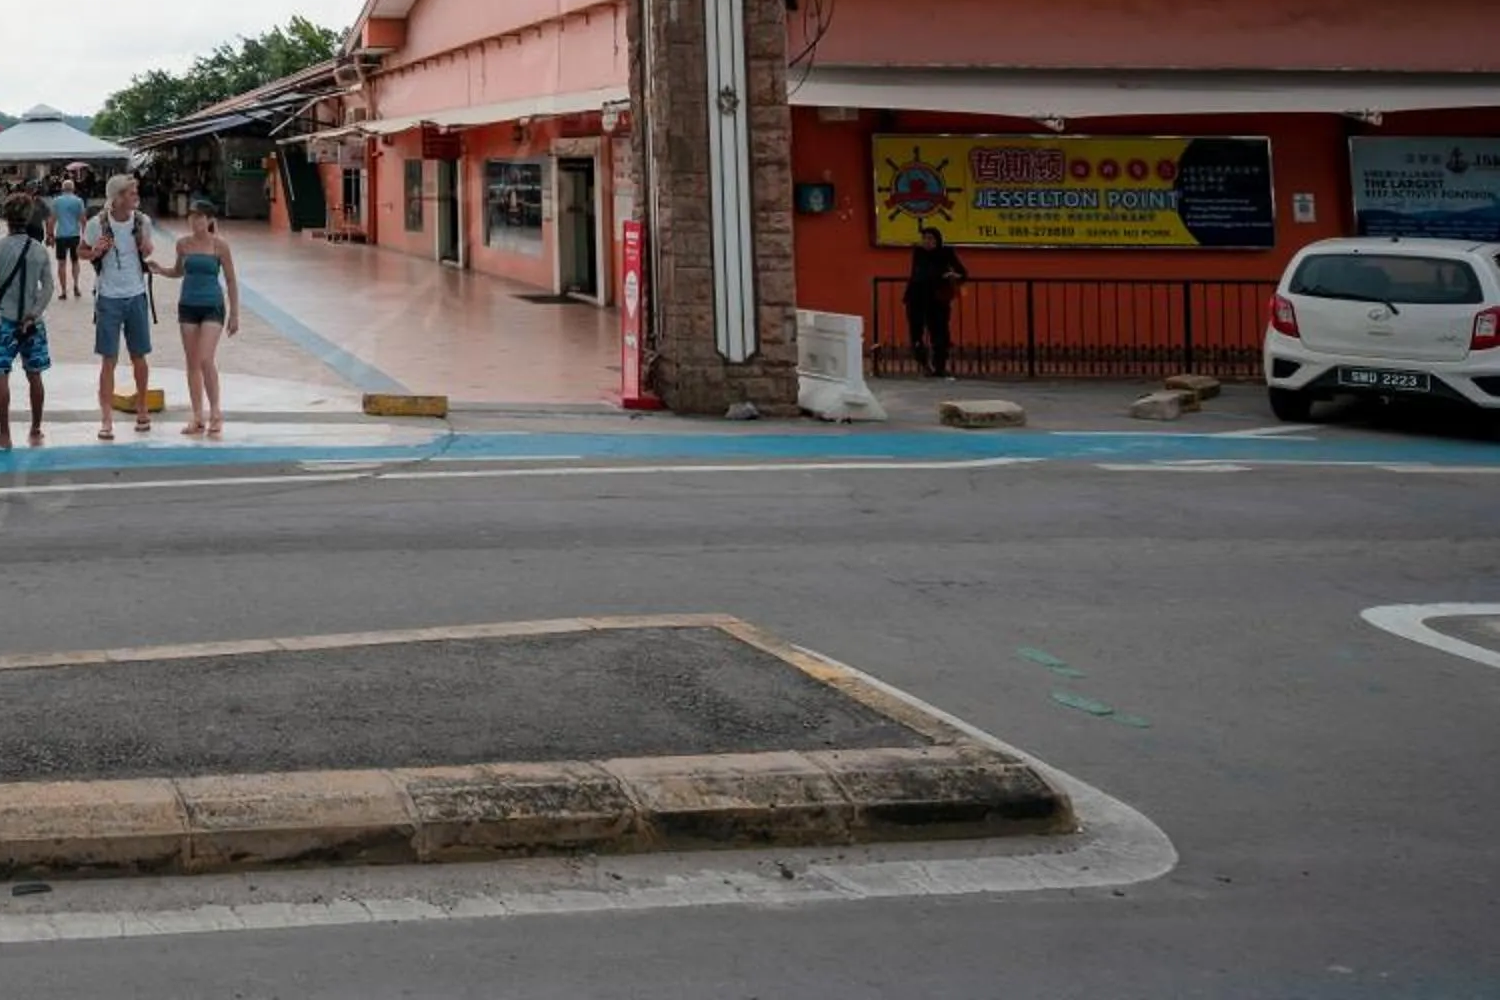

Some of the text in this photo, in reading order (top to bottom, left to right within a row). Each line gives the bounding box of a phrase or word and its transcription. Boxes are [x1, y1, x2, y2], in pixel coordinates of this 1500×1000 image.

[1364, 178, 1445, 189] THE LARGEST
[974, 189, 1180, 210] JESSELTON POINT
[1382, 373, 1418, 387] 2223
